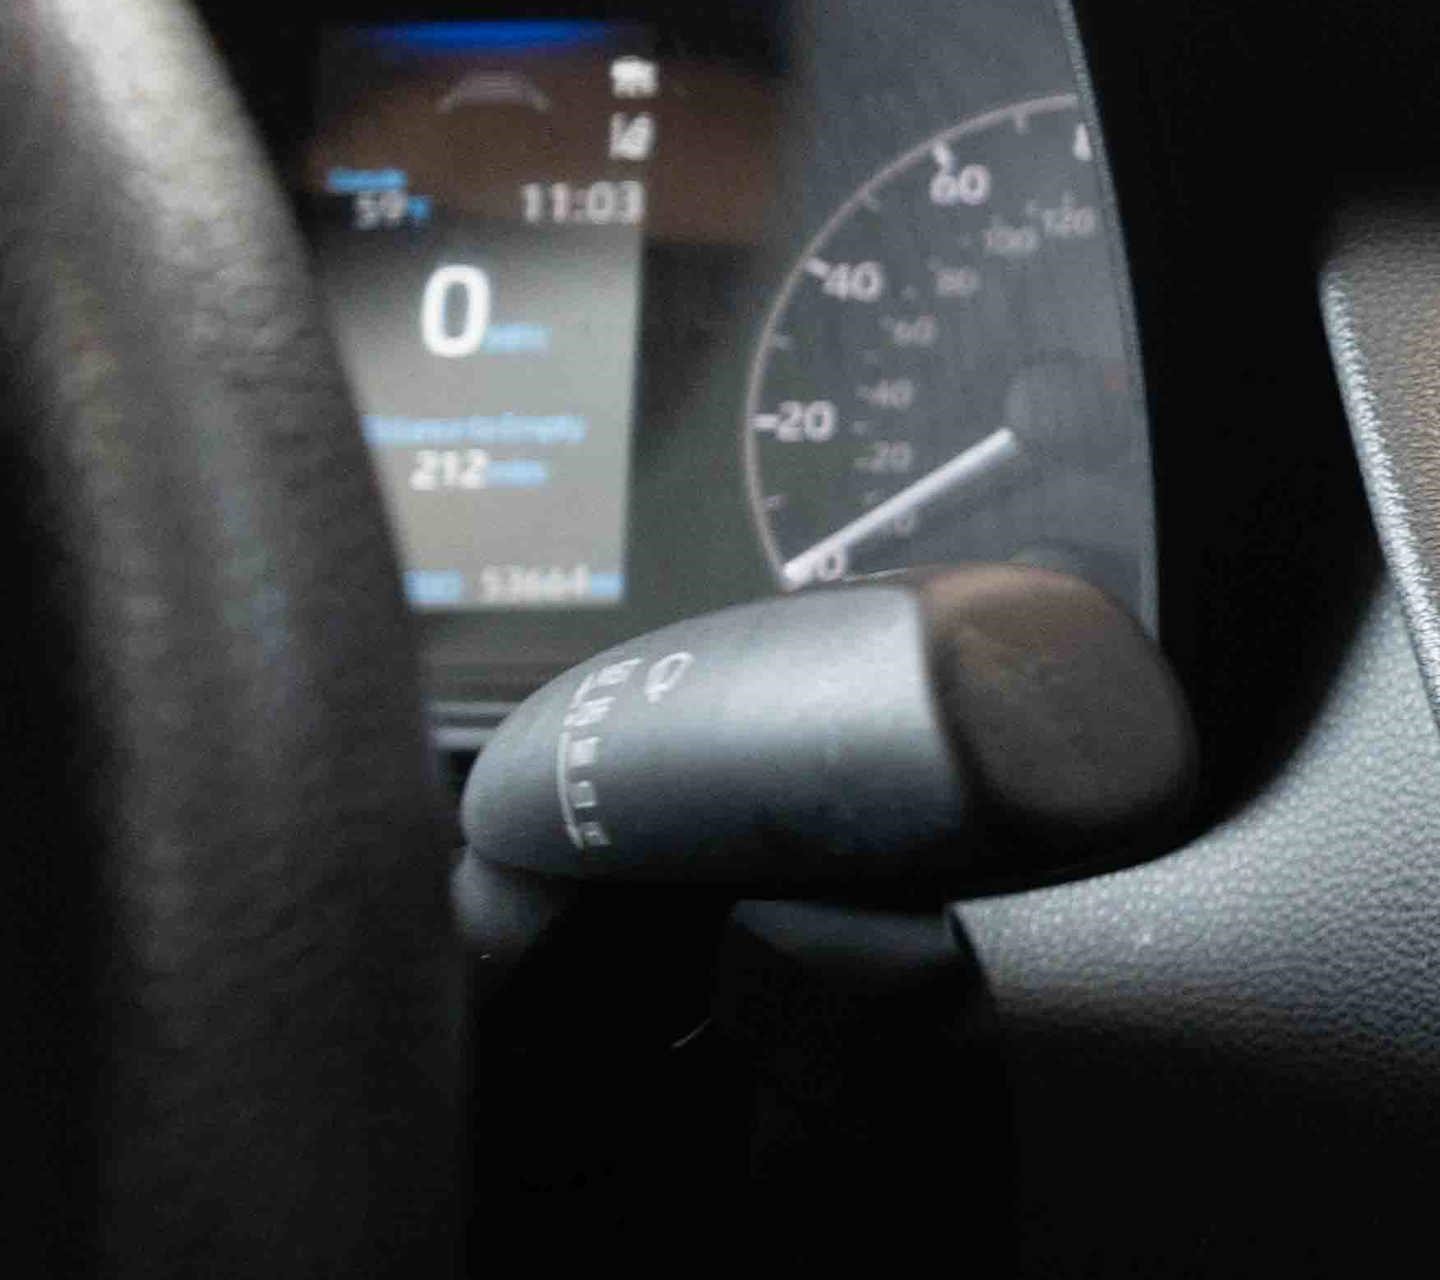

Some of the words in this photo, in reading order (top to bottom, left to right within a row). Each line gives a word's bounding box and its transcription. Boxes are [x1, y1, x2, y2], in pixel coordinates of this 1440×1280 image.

[521, 180, 646, 226] 11:03
[929, 163, 992, 207] 60
[821, 260, 885, 303] 40
[421, 264, 491, 359] 0
[773, 399, 839, 444] 20
[408, 448, 489, 492] 212
